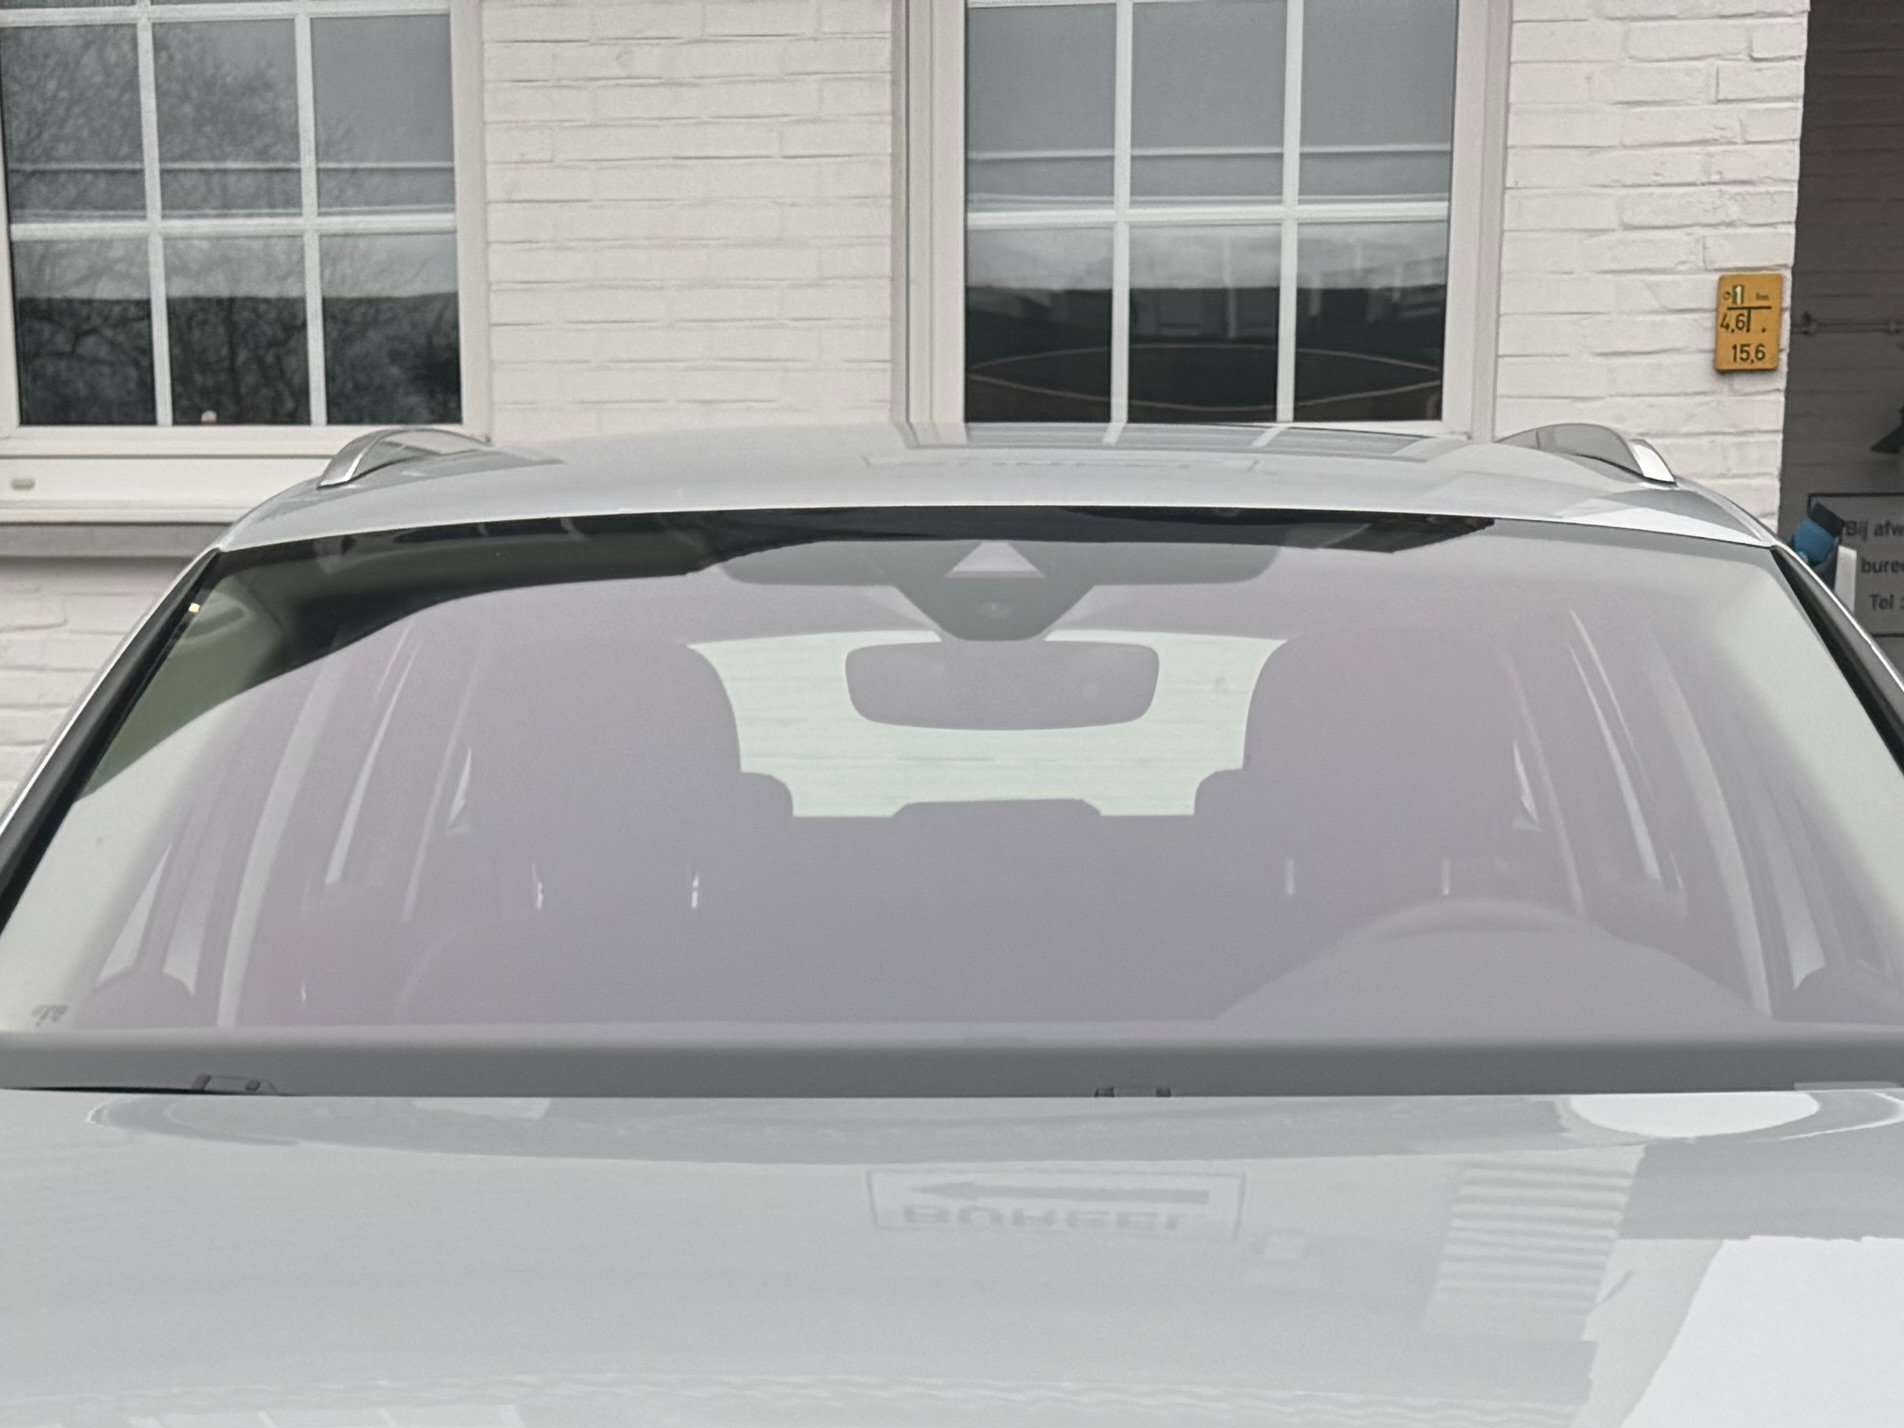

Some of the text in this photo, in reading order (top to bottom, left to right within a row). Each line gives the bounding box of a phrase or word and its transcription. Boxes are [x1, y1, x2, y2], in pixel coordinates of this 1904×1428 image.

[1732, 343, 1766, 364] 15,6
[1845, 520, 1869, 541] Bij
[1869, 594, 1894, 611] Tel
